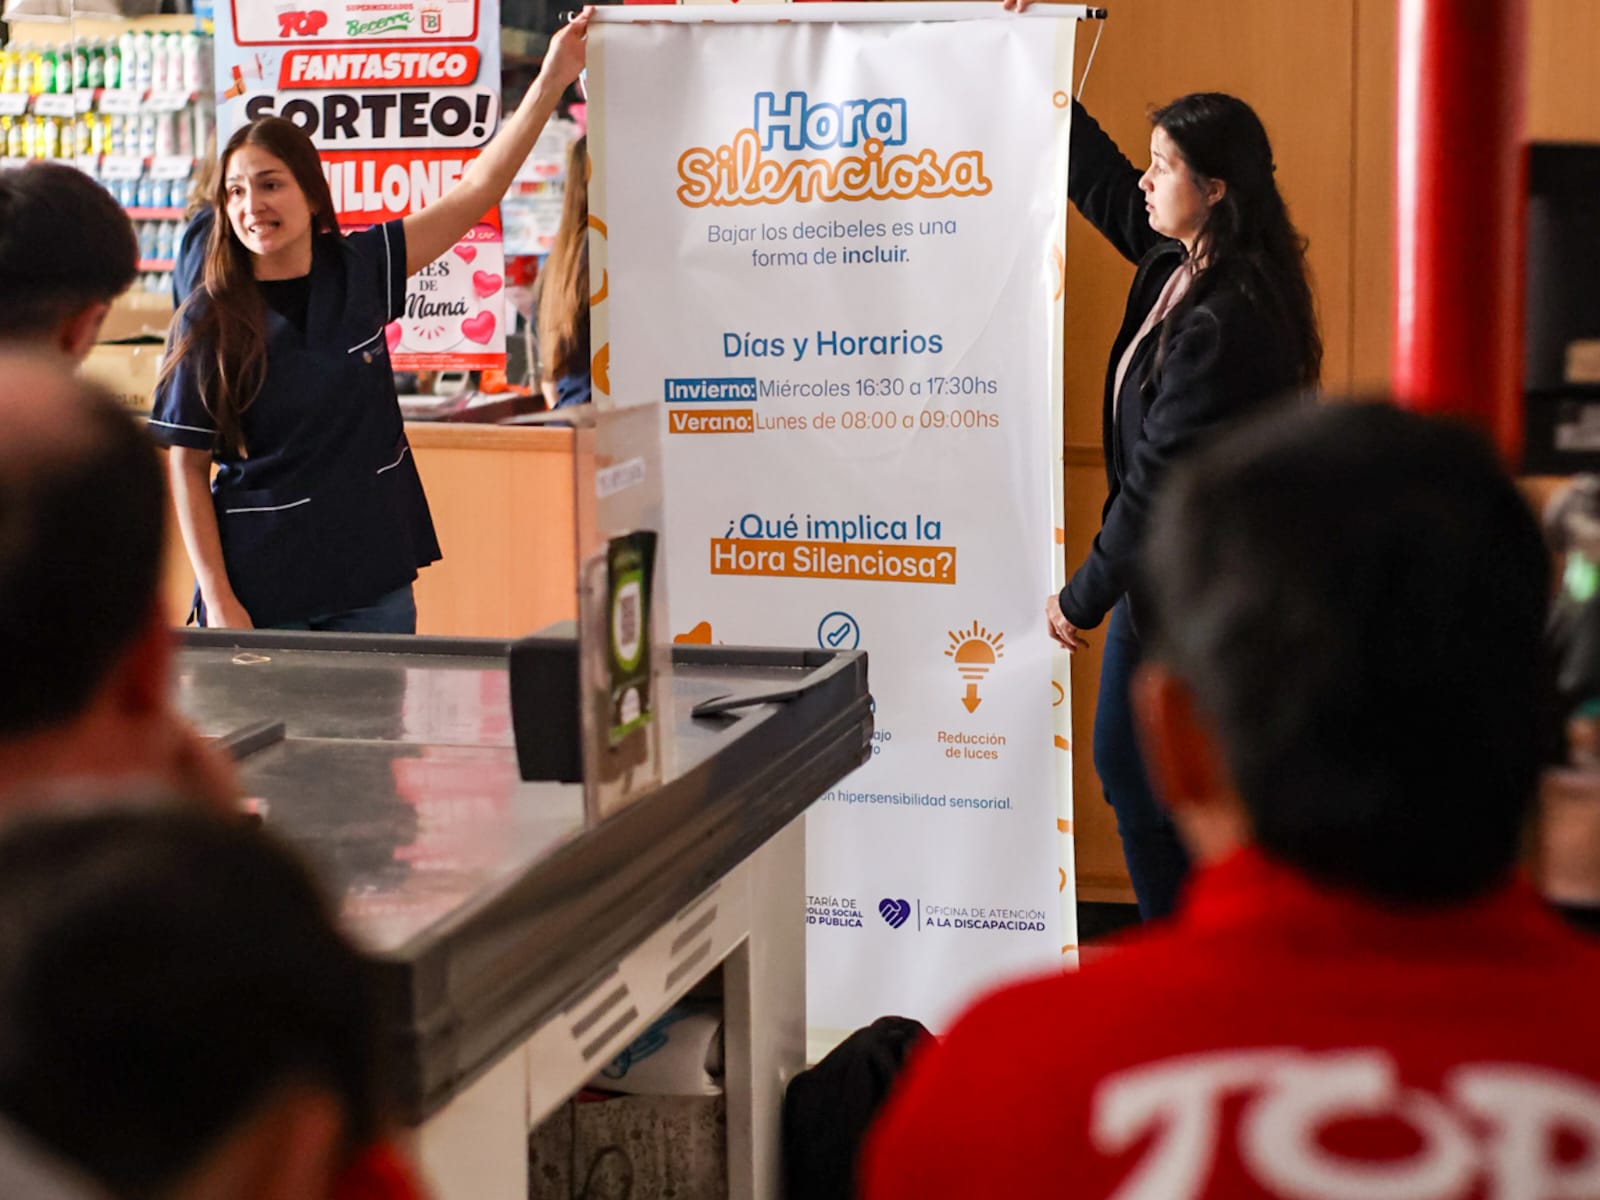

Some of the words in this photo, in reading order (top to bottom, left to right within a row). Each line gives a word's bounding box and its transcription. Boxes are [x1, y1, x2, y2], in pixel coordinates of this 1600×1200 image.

[278, 10, 328, 38] TOP
[346, 12, 415, 36] Becerra
[290, 52, 468, 81] FANTASTICO
[754, 91, 907, 150] Hora
[677, 128, 992, 208] Silenciosa
[320, 158, 477, 214] ILLONE
[708, 224, 756, 245] Bajar
[761, 224, 788, 240] los
[792, 220, 886, 240] decibeles
[891, 221, 914, 237] es
[919, 218, 957, 235] una
[752, 249, 808, 267] forma
[813, 248, 837, 266] de
[842, 246, 910, 264] incluir.
[419, 261, 450, 277] ES
[419, 279, 438, 291] DE
[723, 332, 785, 358] Días
[793, 336, 808, 361] y
[816, 330, 943, 356] Horarios
[668, 380, 756, 399] Invierno:
[759, 378, 851, 398] Miércoles
[856, 378, 904, 396] 16:30
[909, 381, 921, 395] a
[927, 376, 998, 395] 17:30hs
[672, 412, 753, 431] Verano:
[756, 412, 807, 430] Lunes
[812, 412, 836, 430] de
[841, 410, 897, 429] 08:00
[902, 414, 914, 429] a
[919, 409, 1000, 428] 09:00hs
[725, 513, 799, 540] ¿Qué
[806, 514, 907, 543] implica
[915, 514, 942, 540] la
[714, 543, 785, 572] Hora
[793, 545, 953, 579] Silenciosa?
[872, 729, 892, 742] ajo
[937, 731, 1006, 746] Reducción
[945, 747, 961, 758] de
[964, 747, 998, 760] luces
[838, 789, 946, 807] hipersensibilidad
[949, 797, 1014, 810] sensorial.
[806, 895, 839, 908] TARÍA
[841, 898, 857, 909] DE
[806, 907, 830, 916] OLLO
[832, 908, 864, 918] SOCIAL
[925, 905, 969, 917] OFICINA
[971, 907, 987, 918] DE
[989, 907, 1045, 920] ATENCIÓN
[819, 915, 863, 928] PÚBLICA
[926, 917, 935, 926] A
[937, 918, 951, 927] LA
[954, 919, 1046, 931] DISCAPACIDAD
[1090, 1045, 1600, 1200] TOP
